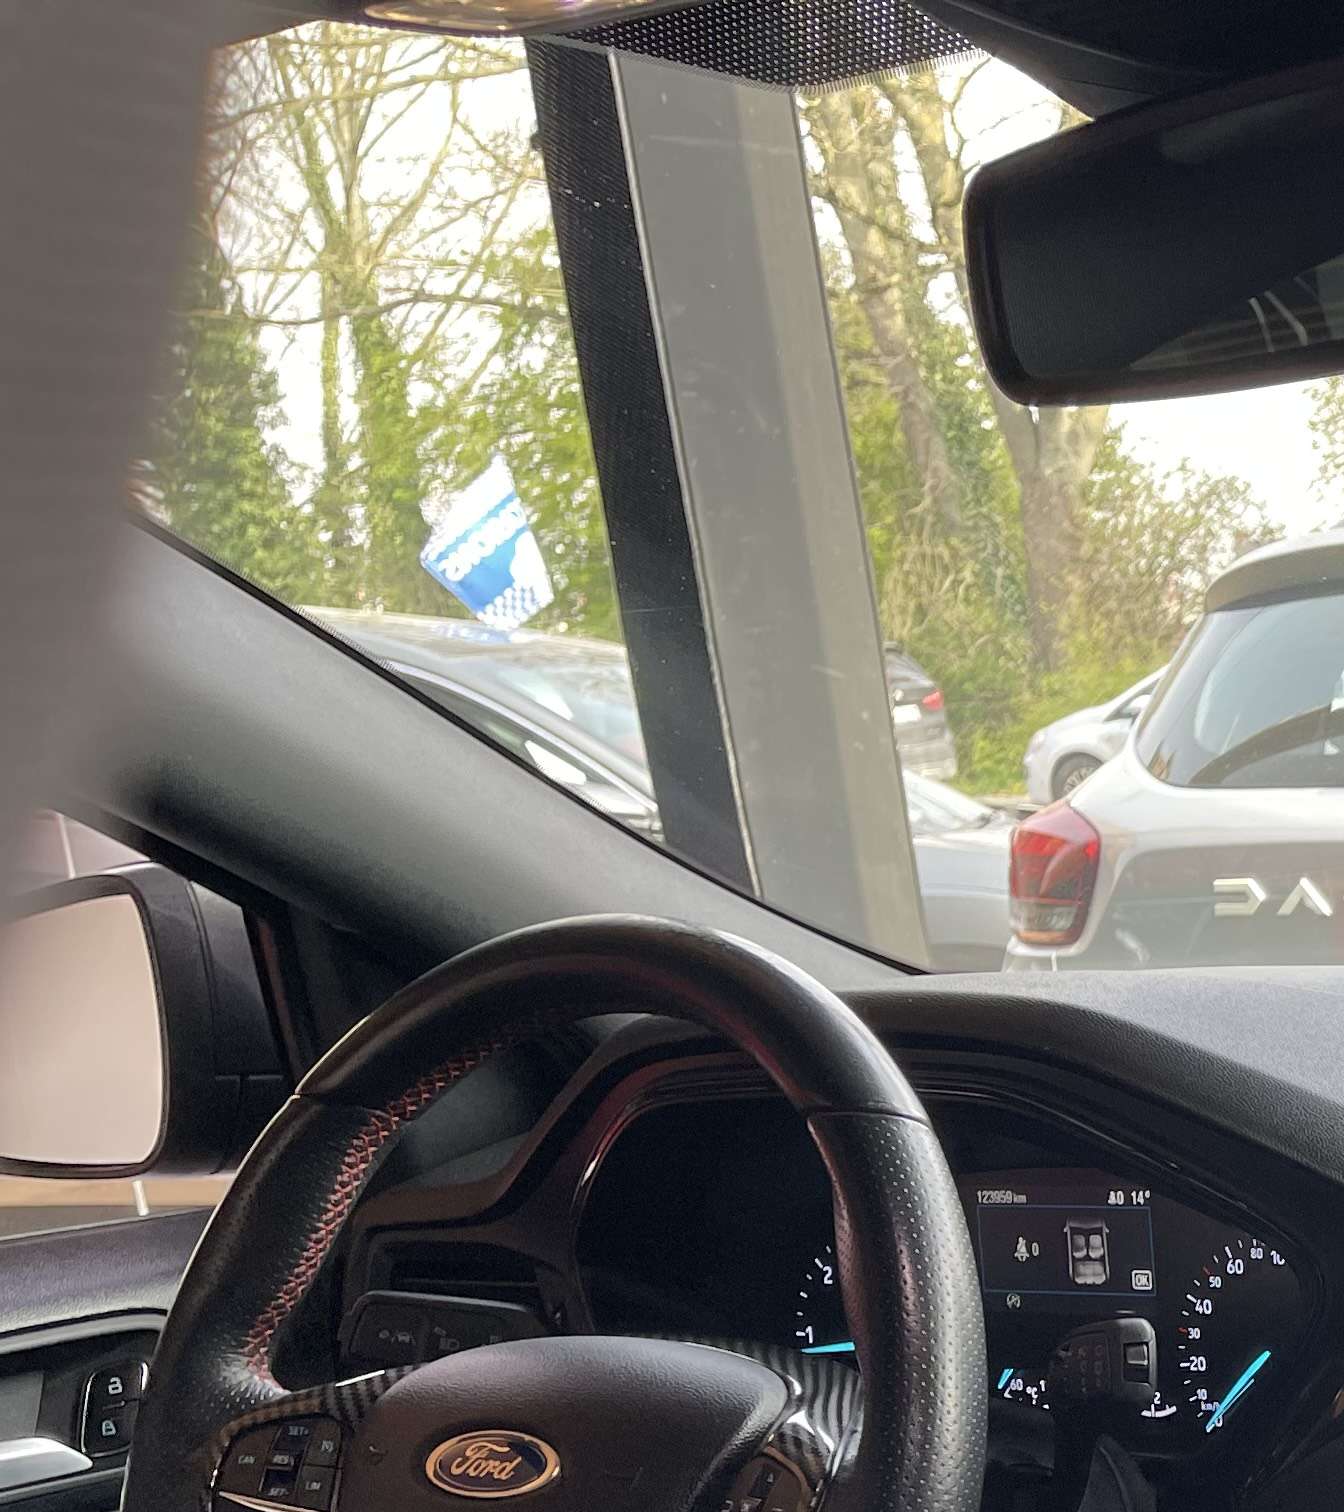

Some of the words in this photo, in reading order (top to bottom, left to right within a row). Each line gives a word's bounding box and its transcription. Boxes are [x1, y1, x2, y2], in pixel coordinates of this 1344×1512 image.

[1250, 1247, 1264, 1259] 80
[1226, 1259, 1244, 1275] 60
[823, 1266, 833, 1284] 2
[1135, 1274, 1150, 1286] OK
[1209, 1276, 1222, 1288] 50
[1195, 1299, 1213, 1314] 40
[805, 1326, 813, 1344] 1
[1188, 1327, 1201, 1339] 30
[1189, 1356, 1207, 1371] 20
[1010, 1378, 1023, 1391] 60
[1196, 1389, 1207, 1400] 10
[450, 1441, 522, 1481] Ford
